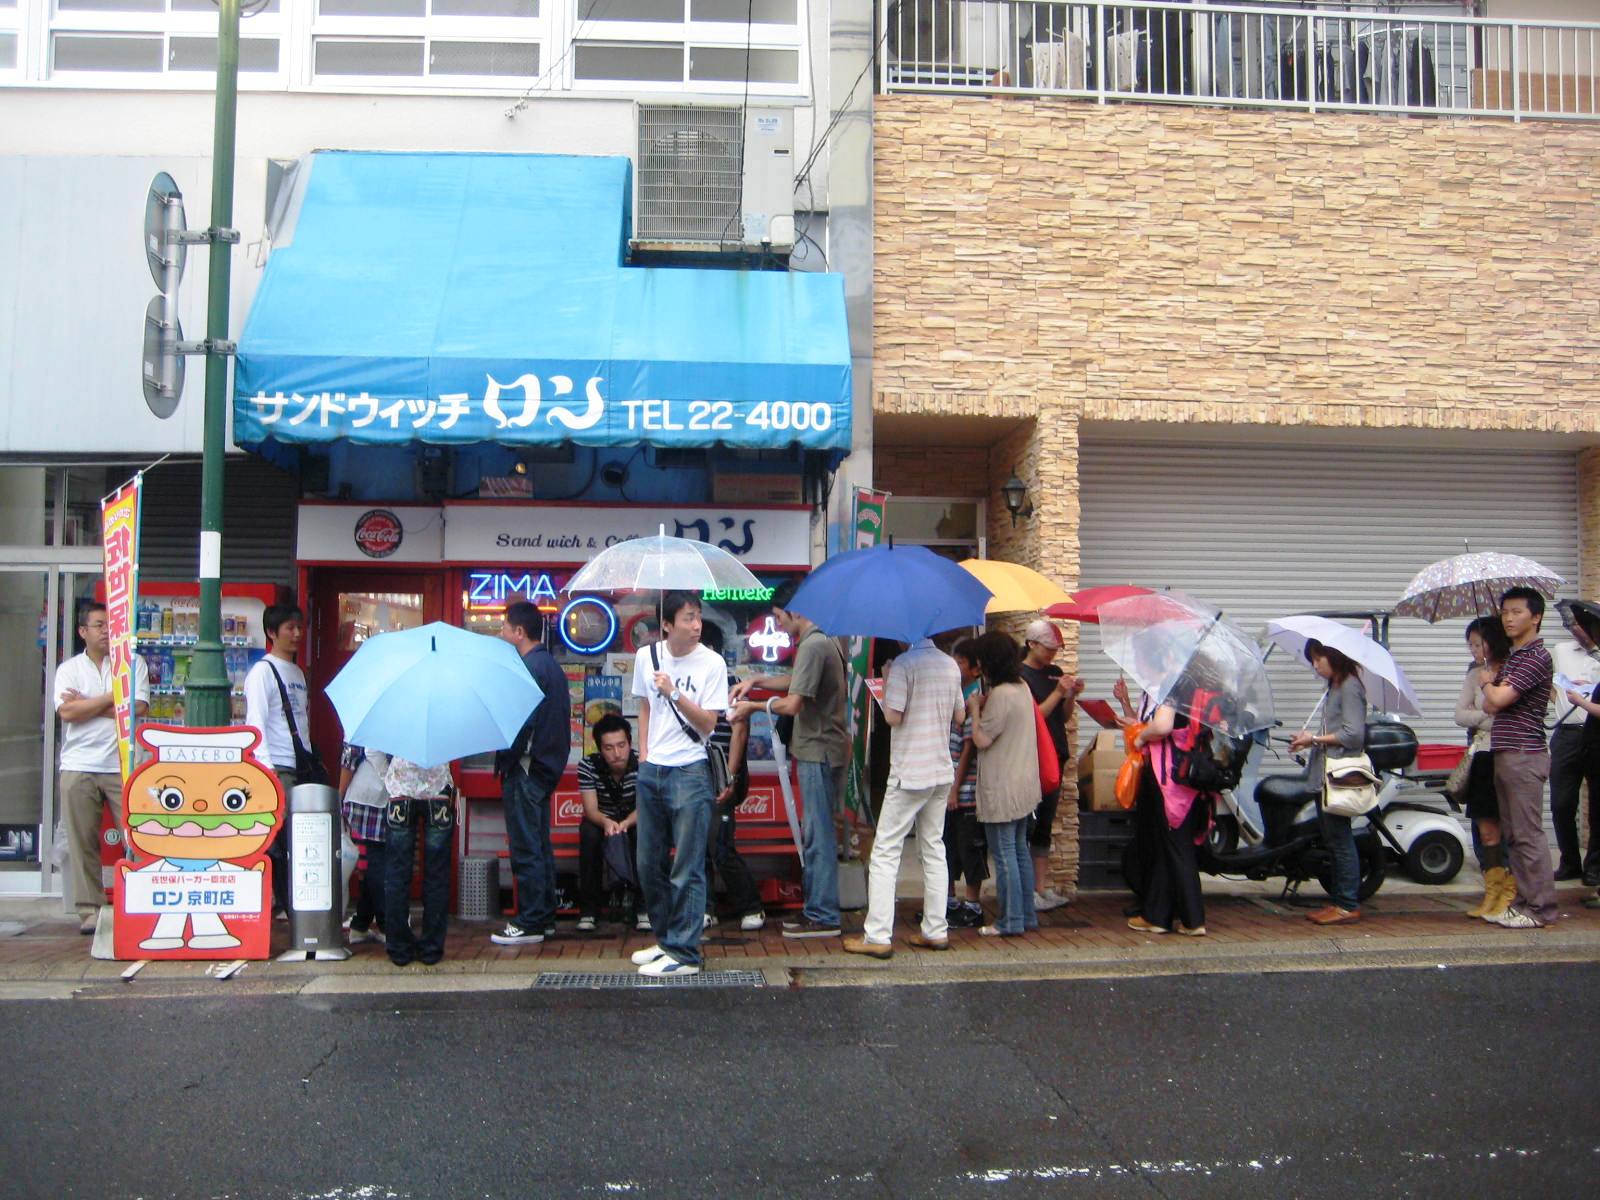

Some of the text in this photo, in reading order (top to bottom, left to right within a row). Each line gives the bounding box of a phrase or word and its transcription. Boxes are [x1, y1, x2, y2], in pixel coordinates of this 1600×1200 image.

[249, 391, 470, 430] サンドウィッチ
[621, 400, 684, 431] TEL
[688, 400, 832, 431] 22-4000
[496, 533, 543, 548] Sand
[547, 535, 582, 548] wich
[587, 537, 597, 548] &
[470, 574, 557, 600] ZIMA
[166, 748, 235, 761] SASEBO
[152, 890, 235, 906] ロン 京町店
